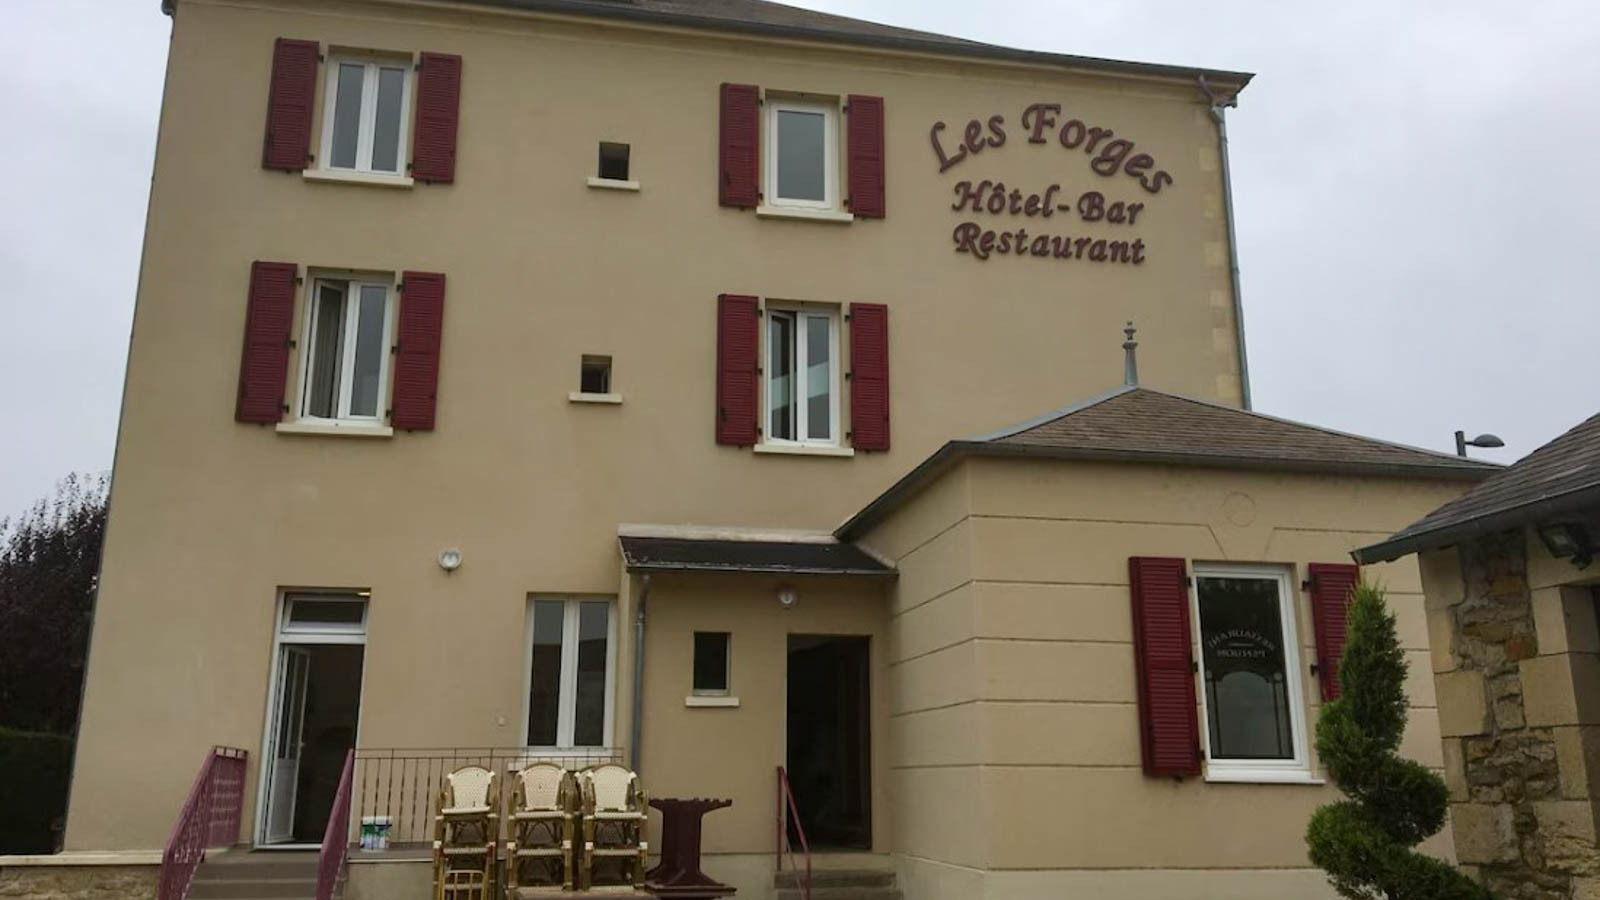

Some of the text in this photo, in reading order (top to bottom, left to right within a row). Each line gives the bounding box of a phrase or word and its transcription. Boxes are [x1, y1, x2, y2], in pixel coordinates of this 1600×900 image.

[930, 103, 1173, 194] Les Forges
[952, 221, 1145, 265] Restaurant
